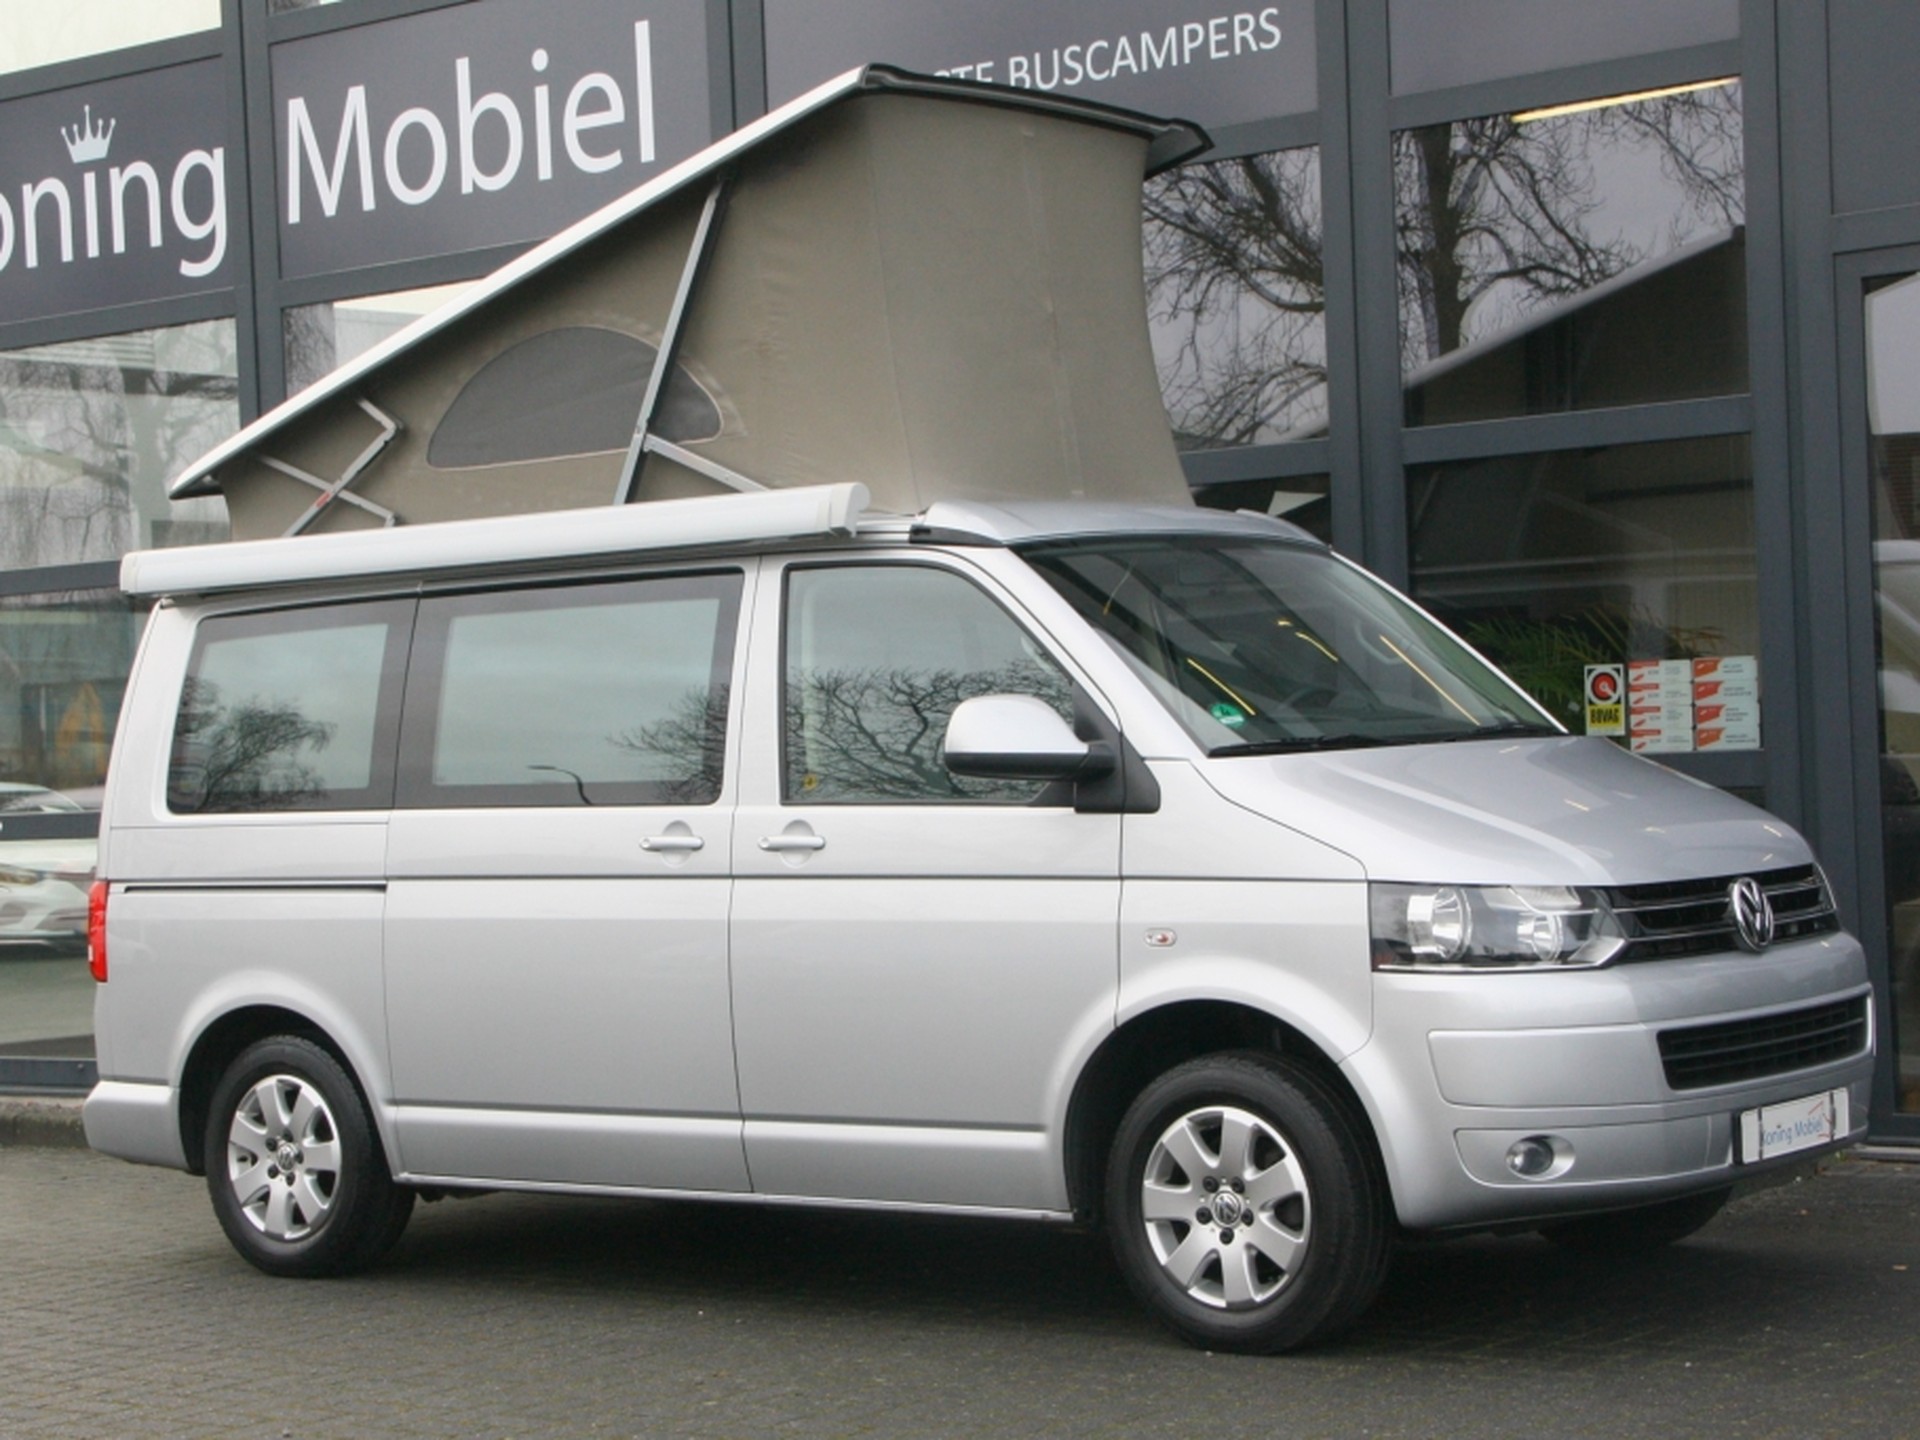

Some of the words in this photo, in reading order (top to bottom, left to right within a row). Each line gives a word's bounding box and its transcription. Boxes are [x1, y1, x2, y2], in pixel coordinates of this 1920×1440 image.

[1009, 7, 1283, 90] BUSCAMPERS
[0, 147, 228, 277] ning
[287, 20, 656, 225] Mobiel
